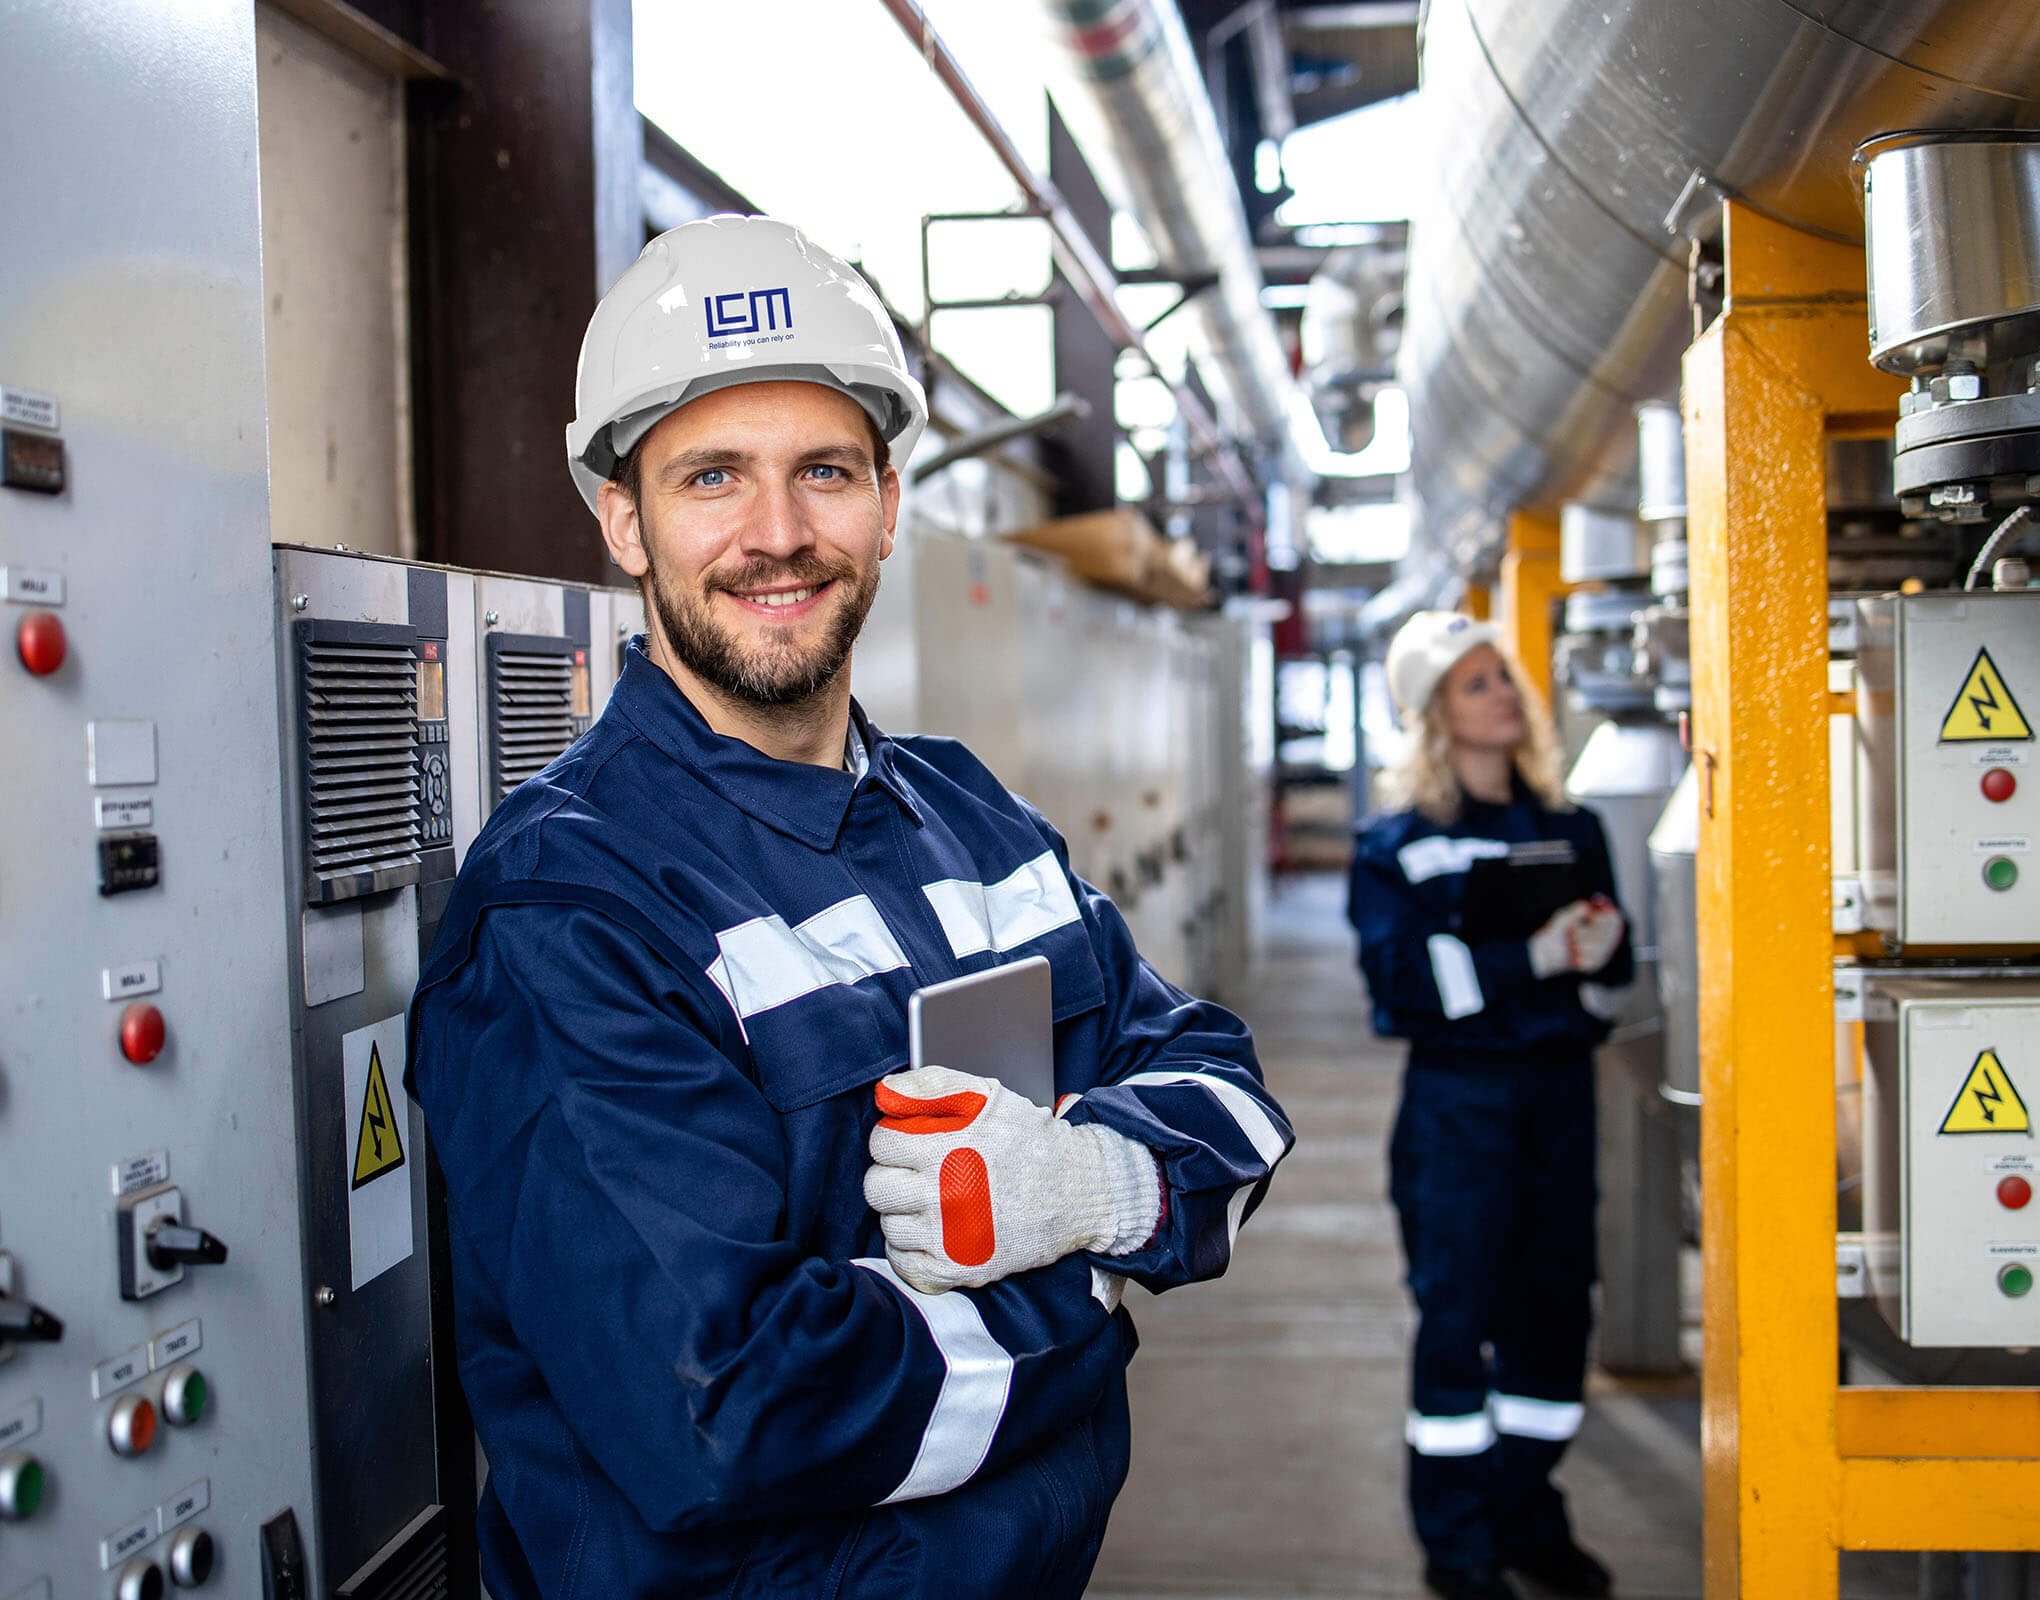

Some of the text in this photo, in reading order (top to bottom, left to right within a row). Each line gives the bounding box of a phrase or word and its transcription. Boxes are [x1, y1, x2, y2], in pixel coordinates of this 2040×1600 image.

[708, 340, 741, 350] Reliability
[743, 338, 755, 346] you
[771, 334, 783, 342] rely
